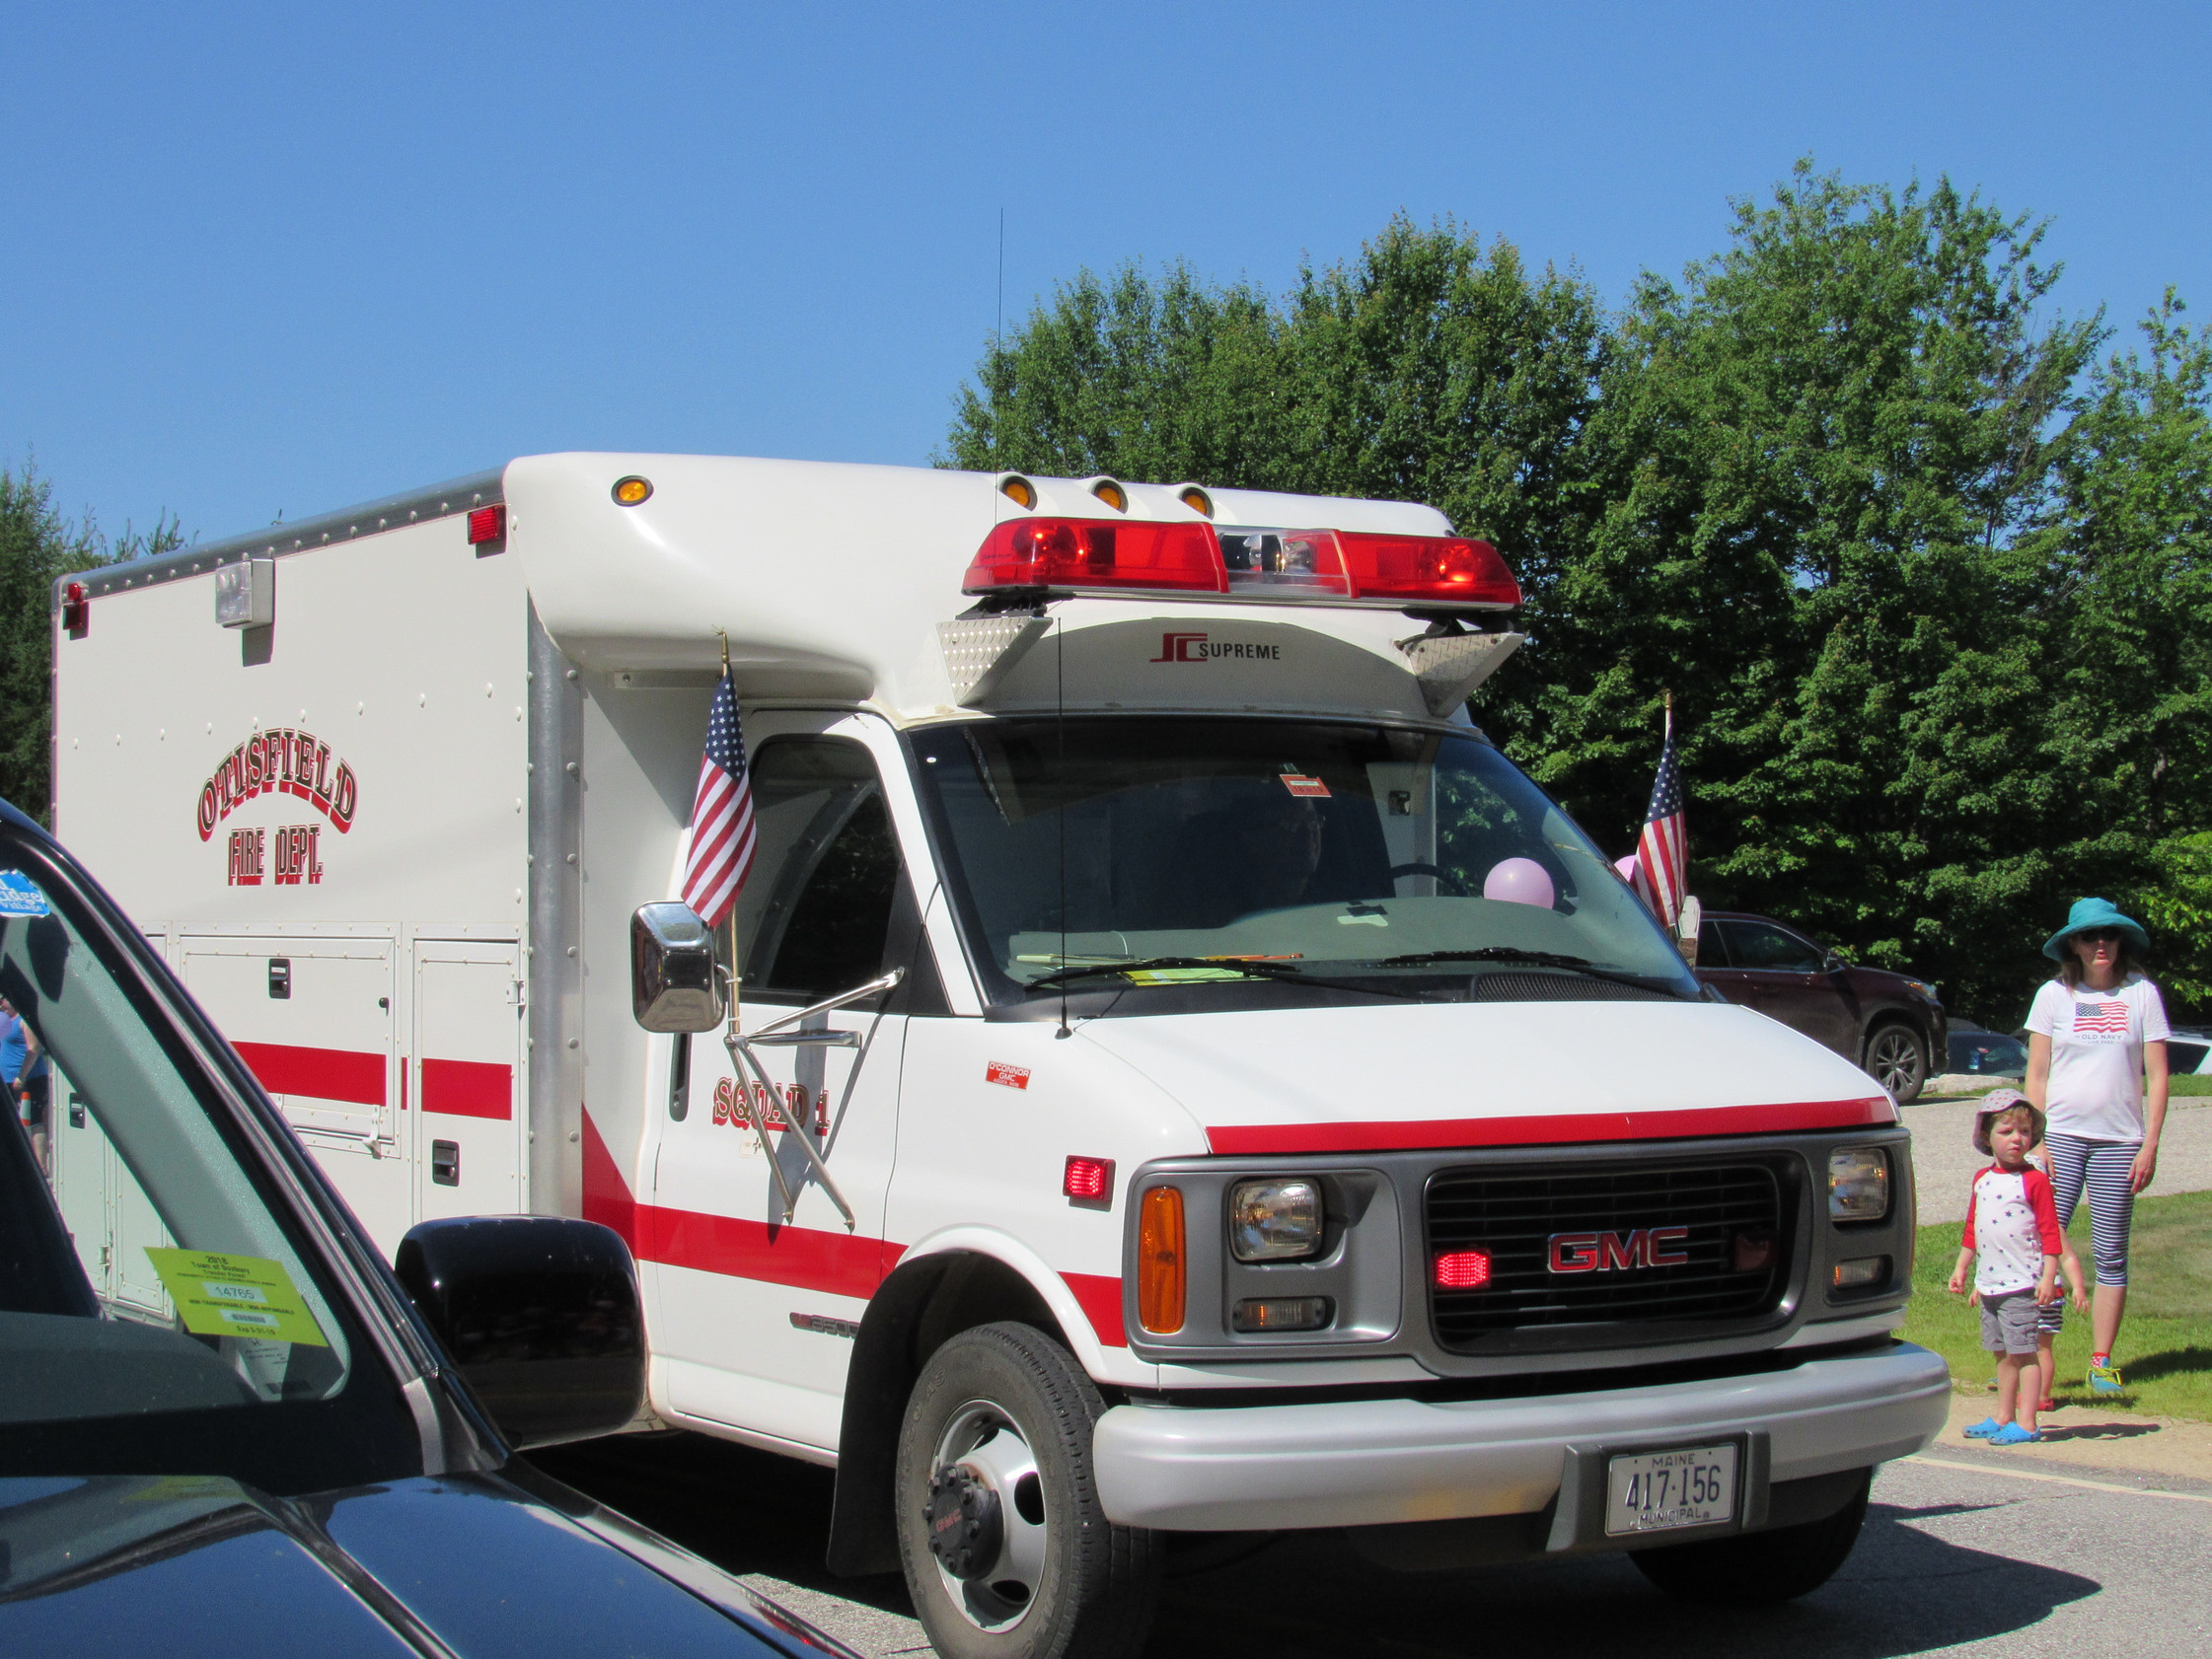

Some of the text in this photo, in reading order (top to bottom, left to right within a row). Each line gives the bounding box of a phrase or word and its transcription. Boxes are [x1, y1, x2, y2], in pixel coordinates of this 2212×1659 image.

[1199, 643, 1281, 660] SUPREME
[197, 728, 358, 842] OTISFIELD
[228, 824, 325, 886] FIRE DEPT.
[989, 1061, 1029, 1077] O'CONNOR
[998, 1071, 1016, 1082] GMC
[712, 1077, 831, 1136] SQUAD 1
[1547, 1225, 1688, 1273] GMC
[190, 1261, 211, 1269] Town
[215, 1286, 255, 1300] 14765
[1652, 1453, 1695, 1469] MAINE
[935, 1508, 963, 1532] GMC
[1639, 1507, 1701, 1525] MUNICIPAL
